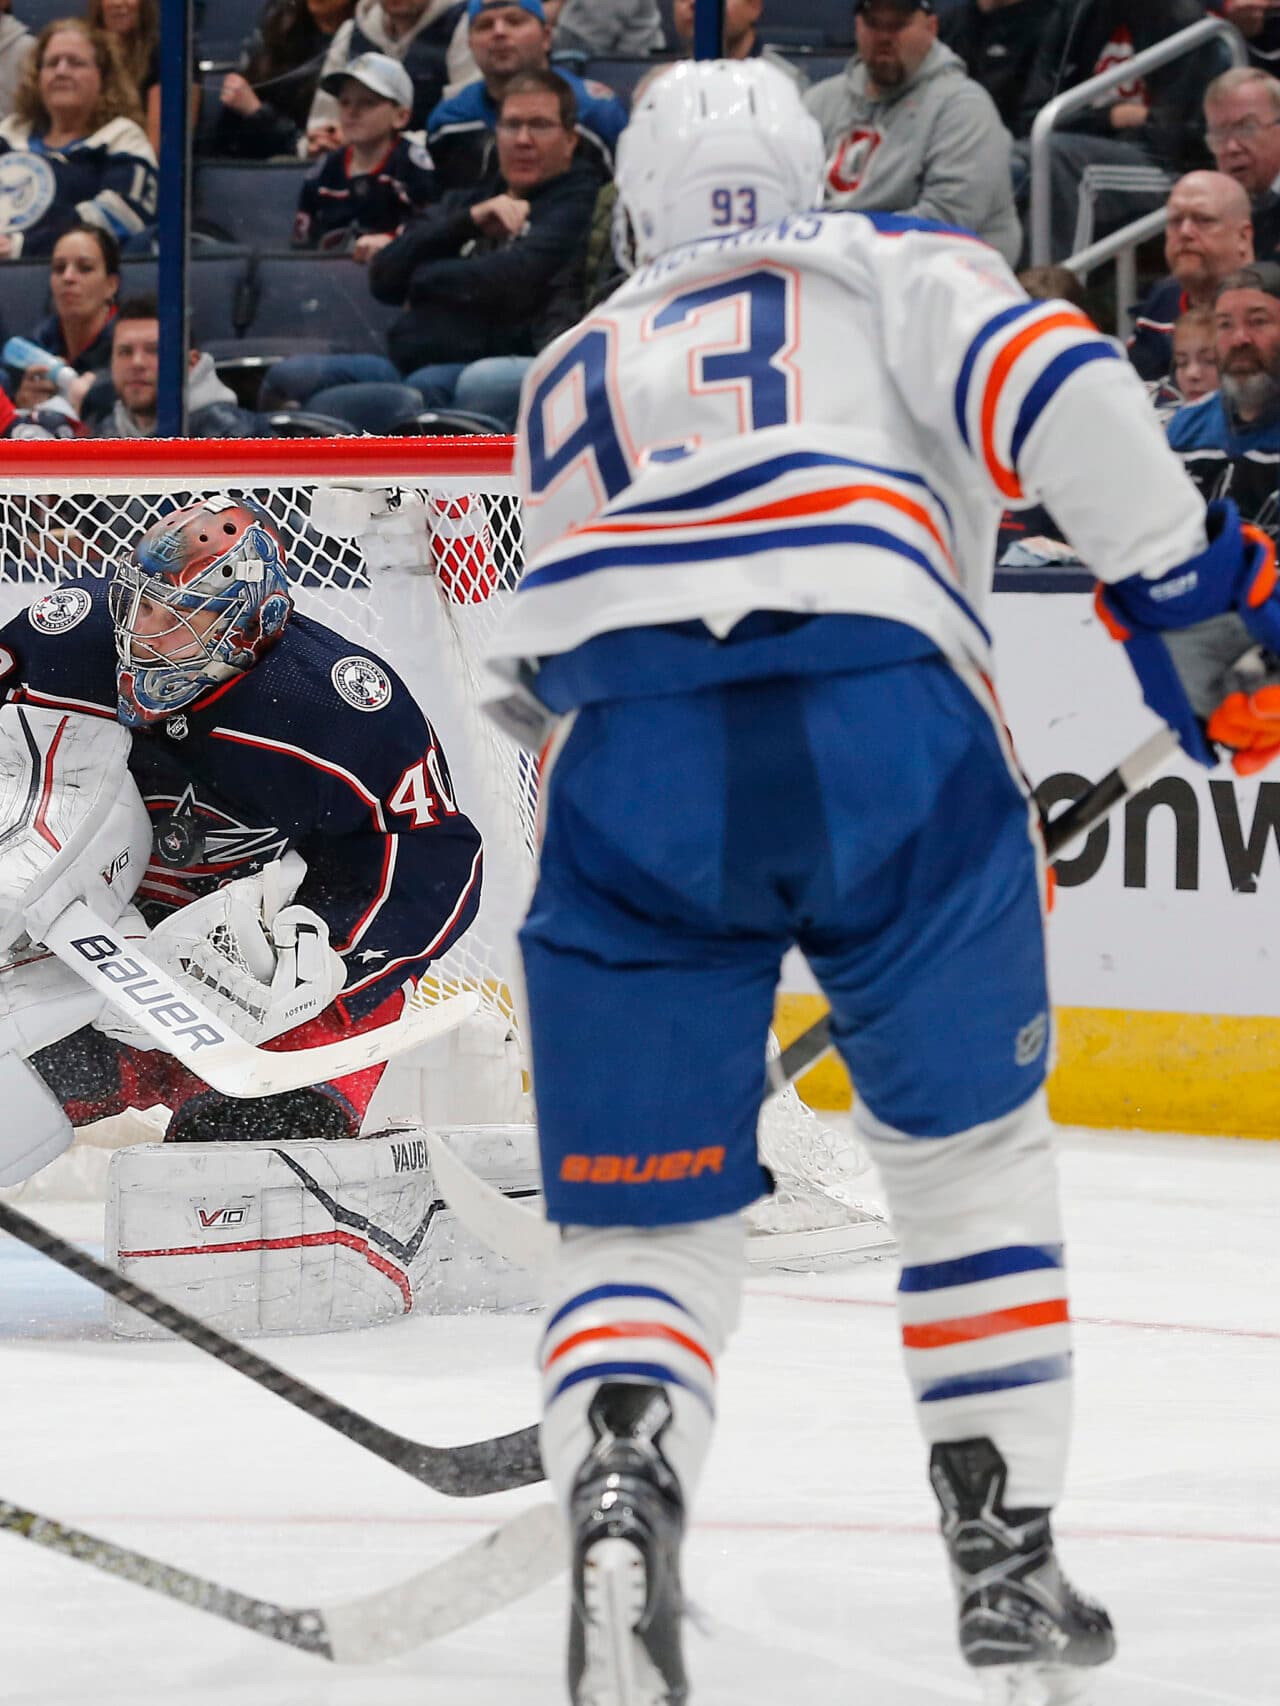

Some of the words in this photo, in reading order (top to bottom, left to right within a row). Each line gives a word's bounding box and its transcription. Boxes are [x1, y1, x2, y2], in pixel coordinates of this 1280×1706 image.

[710, 187, 757, 228] 93
[521, 258, 802, 506] 93
[70, 934, 225, 1051] BAUER
[560, 1145, 726, 1184] BAUER
